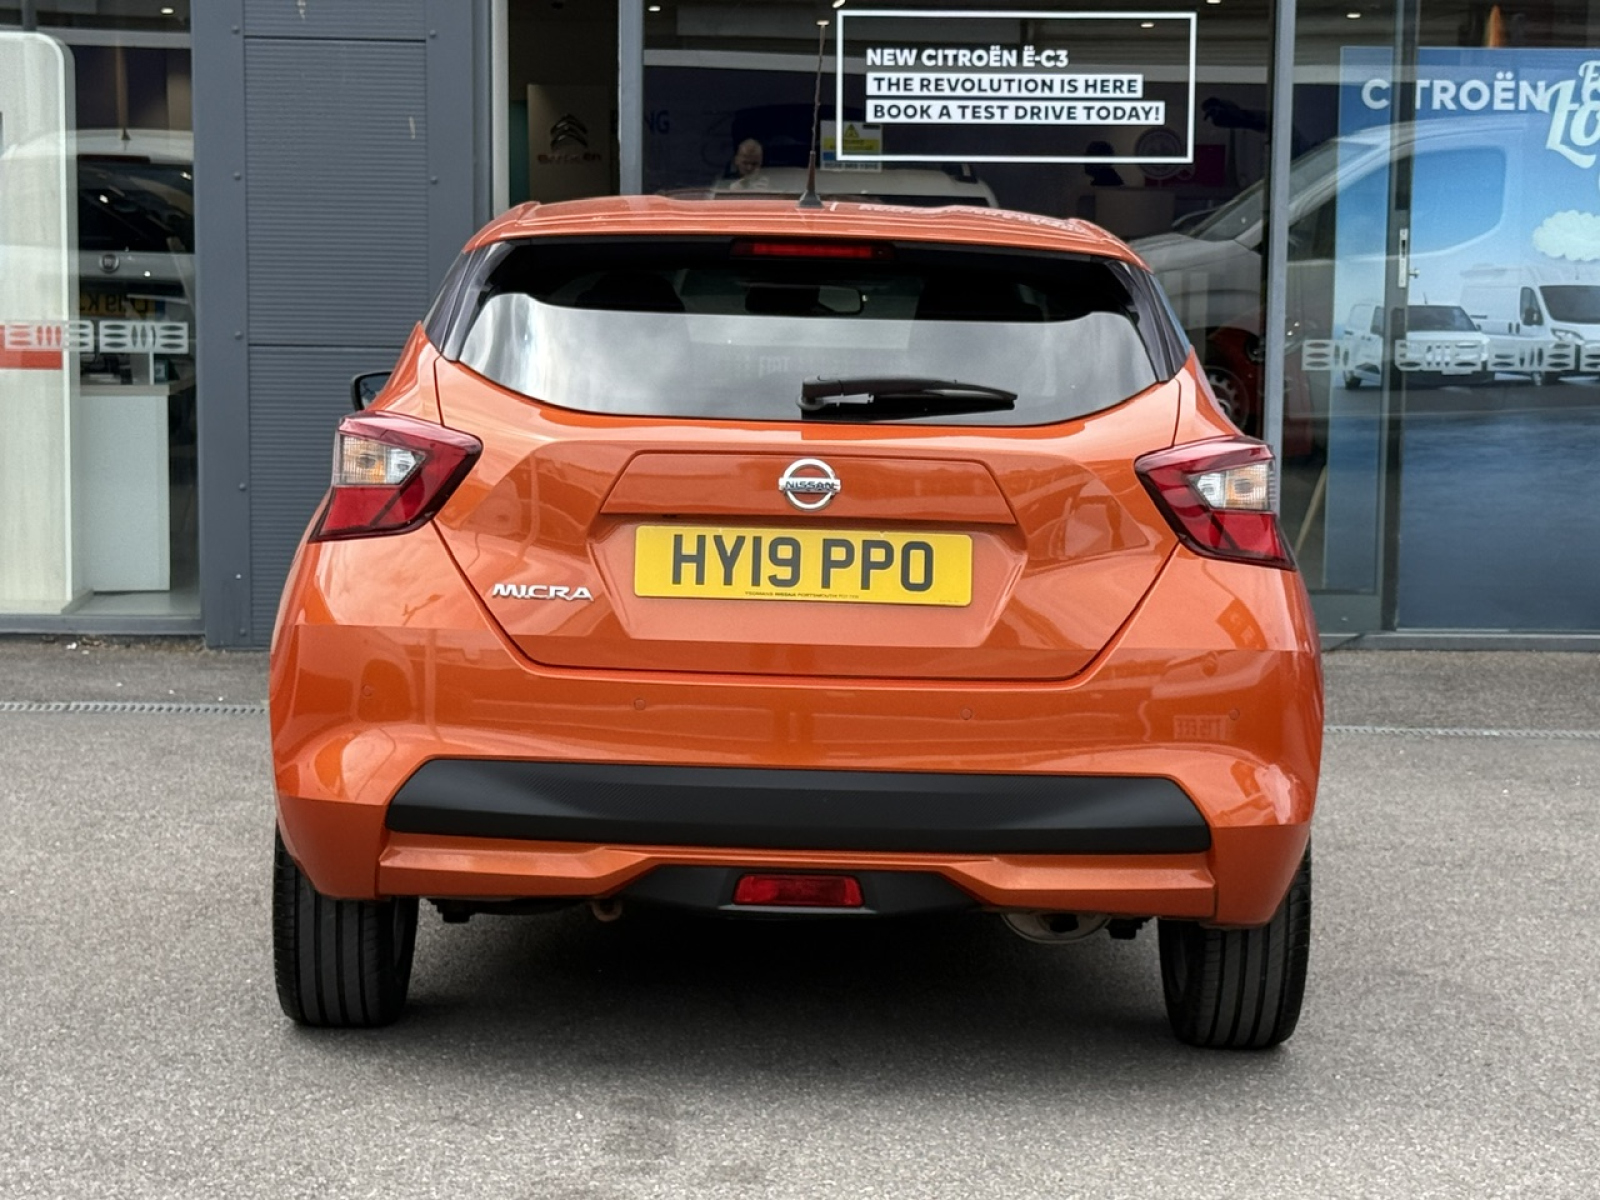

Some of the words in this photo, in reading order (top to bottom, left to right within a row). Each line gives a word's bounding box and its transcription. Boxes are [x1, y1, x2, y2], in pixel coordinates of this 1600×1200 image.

[866, 48, 917, 66] NEW
[922, 46, 1017, 67] CITROËN
[1023, 46, 1069, 68] Ë-C3
[874, 78, 913, 93] THE
[920, 78, 1053, 93] REVOLUTION
[1060, 79, 1078, 94] IS
[1085, 79, 1138, 94] HERE
[1361, 72, 1546, 111] CTROËN
[874, 104, 932, 120] BOOK
[938, 105, 952, 120] A
[958, 105, 1007, 120] TEST
[1015, 105, 1077, 120] DRIVE
[1082, 105, 1160, 121] TODAY!
[785, 481, 835, 490] NISSAN
[671, 534, 801, 587] HY19
[821, 538, 934, 592] PPO
[491, 583, 594, 601] MICRA
